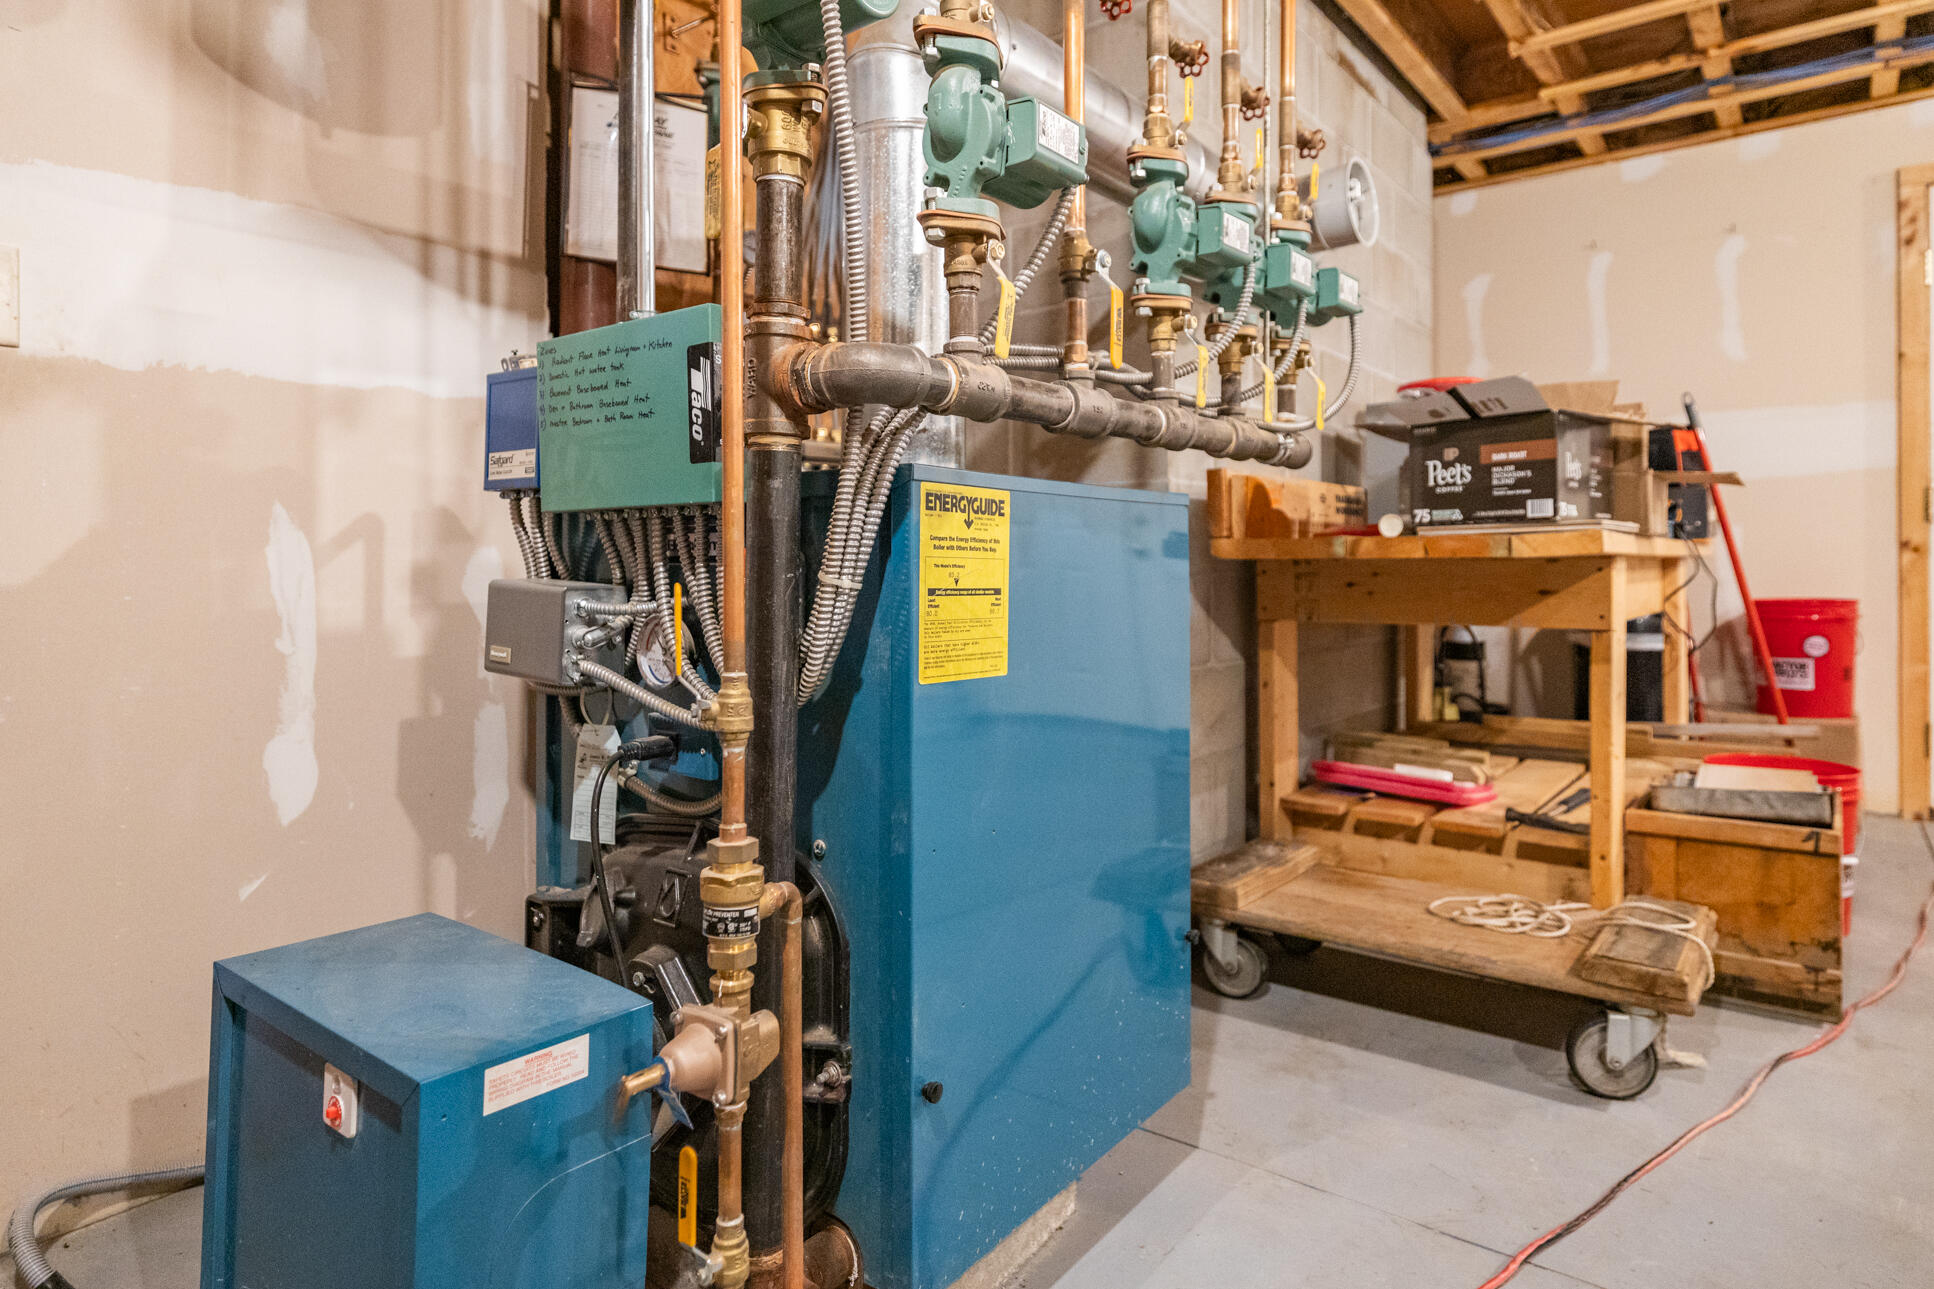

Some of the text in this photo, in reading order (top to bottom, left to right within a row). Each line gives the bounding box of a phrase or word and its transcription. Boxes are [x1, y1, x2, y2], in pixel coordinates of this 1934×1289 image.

[649, 337, 672, 350] Kitchen
[575, 367, 585, 376] Hot
[615, 378, 631, 388] Heat
[634, 392, 650, 404] Heat
[638, 408, 655, 419] Heat
[1425, 460, 1472, 487] Peet's
[1435, 486, 1463, 494] COFFEE
[926, 492, 1005, 517] ENERGYGUIDE
[1413, 508, 1431, 524] 75
